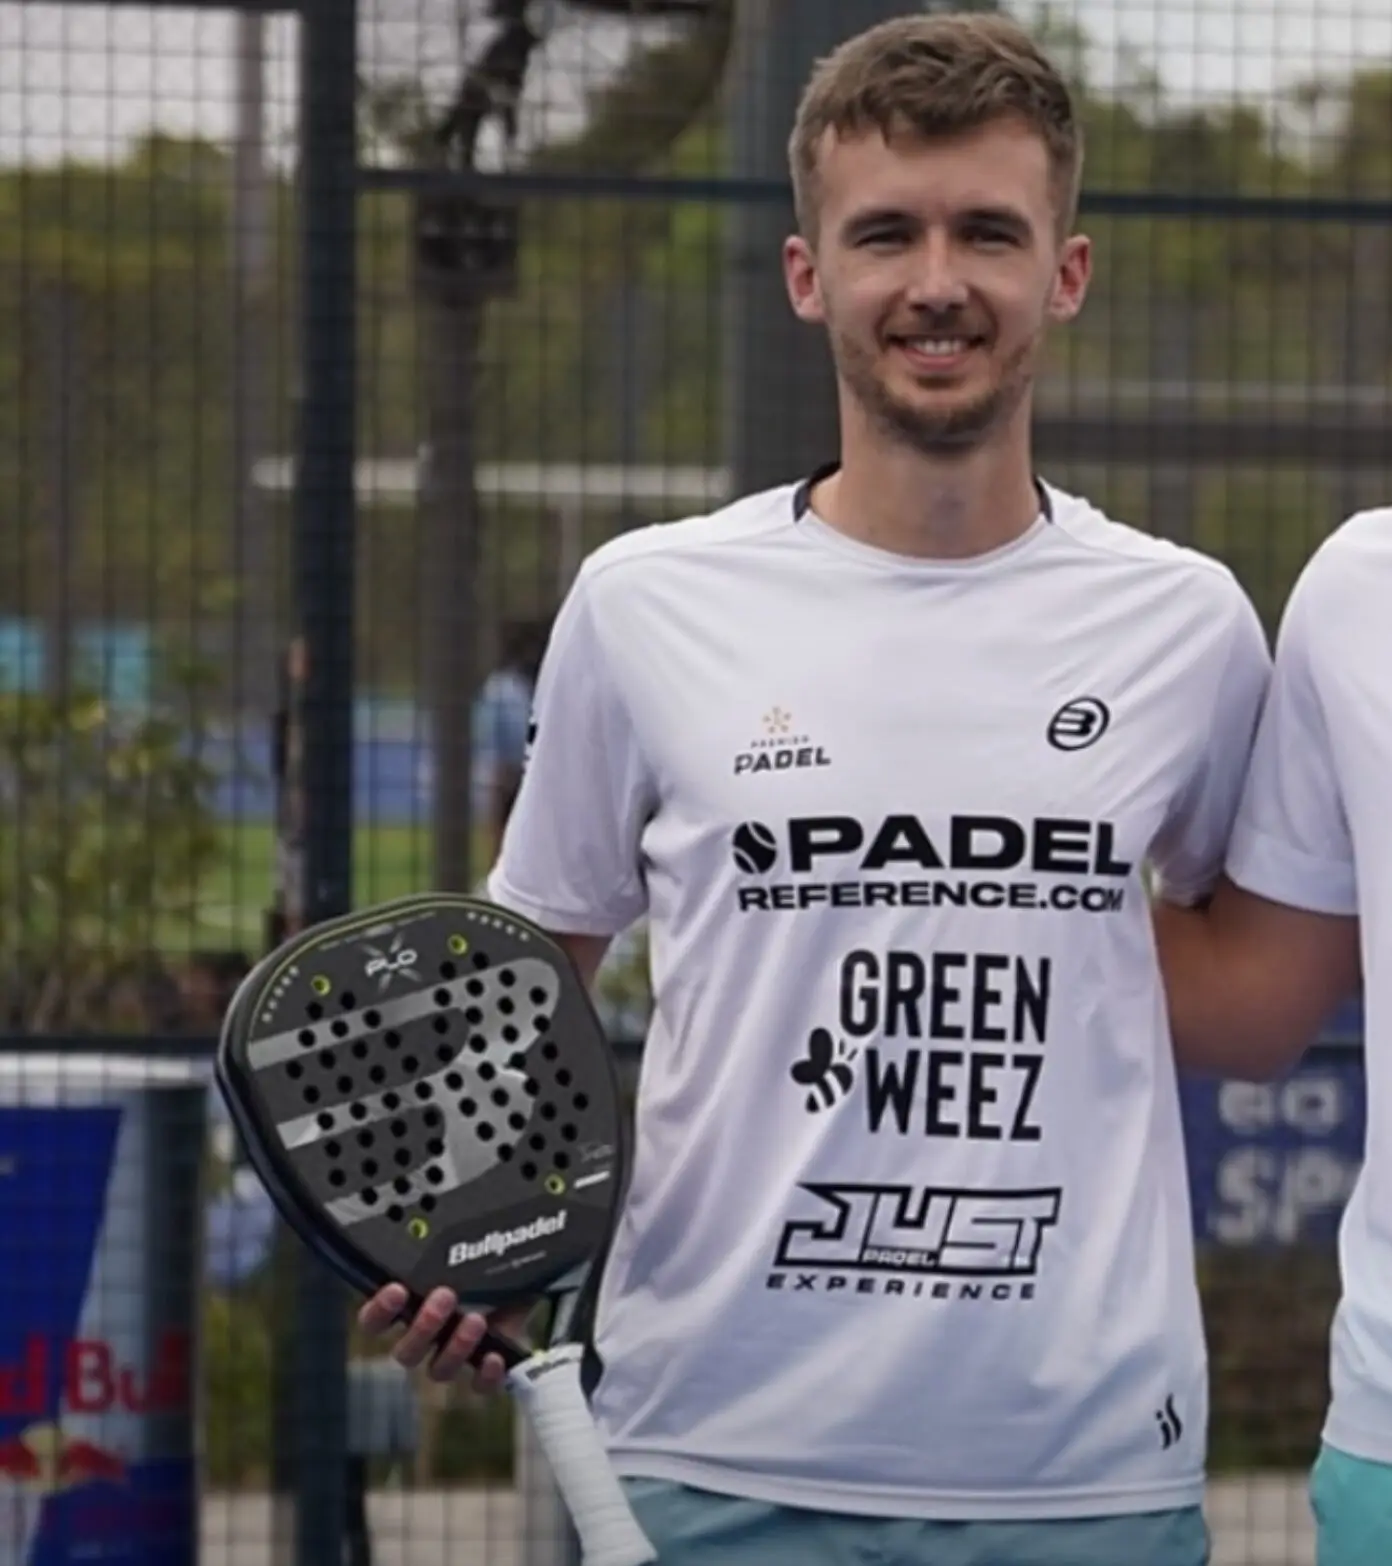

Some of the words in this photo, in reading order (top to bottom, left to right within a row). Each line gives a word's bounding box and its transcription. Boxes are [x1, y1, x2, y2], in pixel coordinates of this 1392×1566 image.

[733, 745, 831, 775] PADEL
[787, 814, 1132, 876] PADEL
[737, 880, 1124, 912] REFERENCE.COM
[839, 949, 1051, 1044] GREEN
[865, 1047, 1044, 1142] WEEZ
[448, 1209, 567, 1266] Bullpadel
[773, 1182, 1063, 1276] JUST
[767, 1273, 1037, 1300] EXPERIENCE
